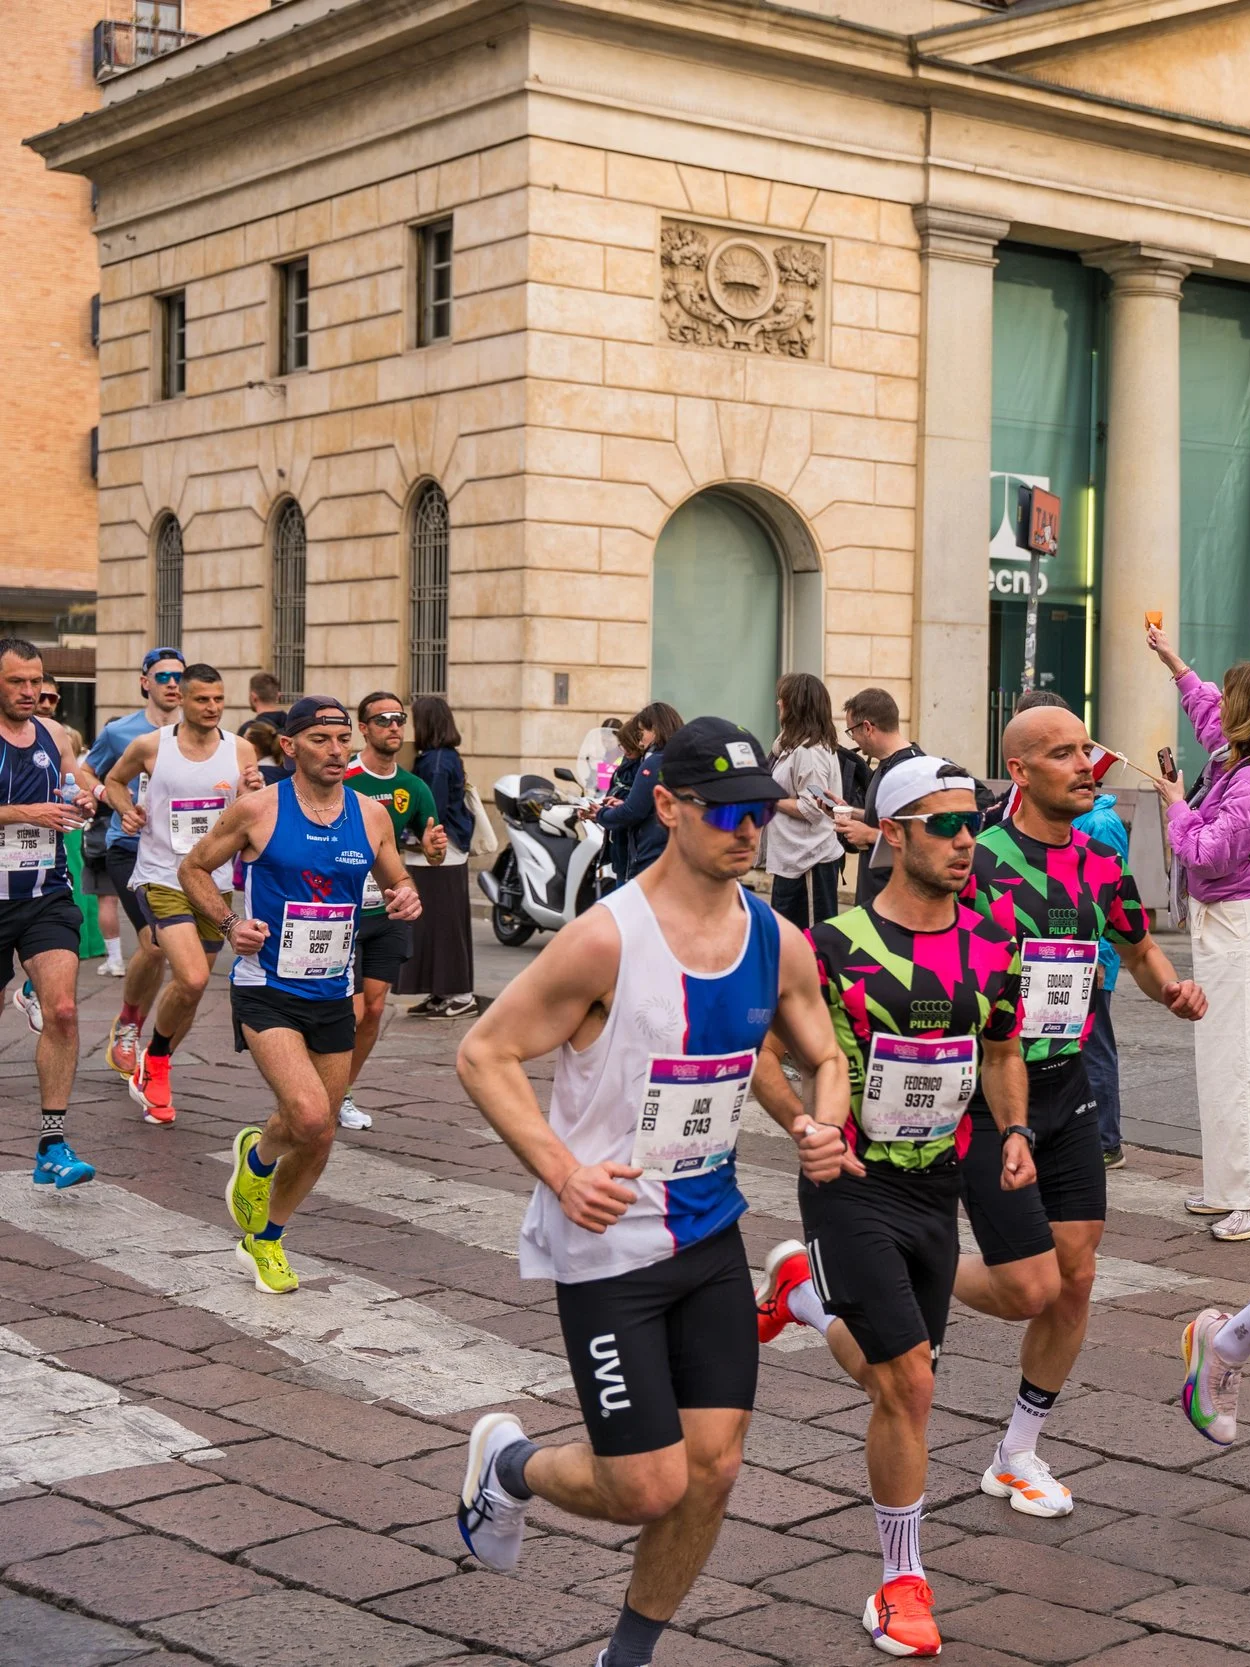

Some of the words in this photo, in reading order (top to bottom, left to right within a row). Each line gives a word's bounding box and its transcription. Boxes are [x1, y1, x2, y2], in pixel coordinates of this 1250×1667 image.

[16, 828, 41, 839] STÉPHANE
[21, 840, 37, 849] 7785
[309, 929, 332, 941] CLAUDIO
[1049, 926, 1078, 935] PILLAR
[309, 943, 329, 954] 8267
[1048, 974, 1073, 989] EDOARDO
[1048, 991, 1069, 1005] 11640
[910, 1020, 950, 1029] PILLAR
[904, 1075, 942, 1091] FEDERICO
[691, 1098, 713, 1115] JACK
[904, 1093, 935, 1108] 9373
[683, 1117, 712, 1137] 6743
